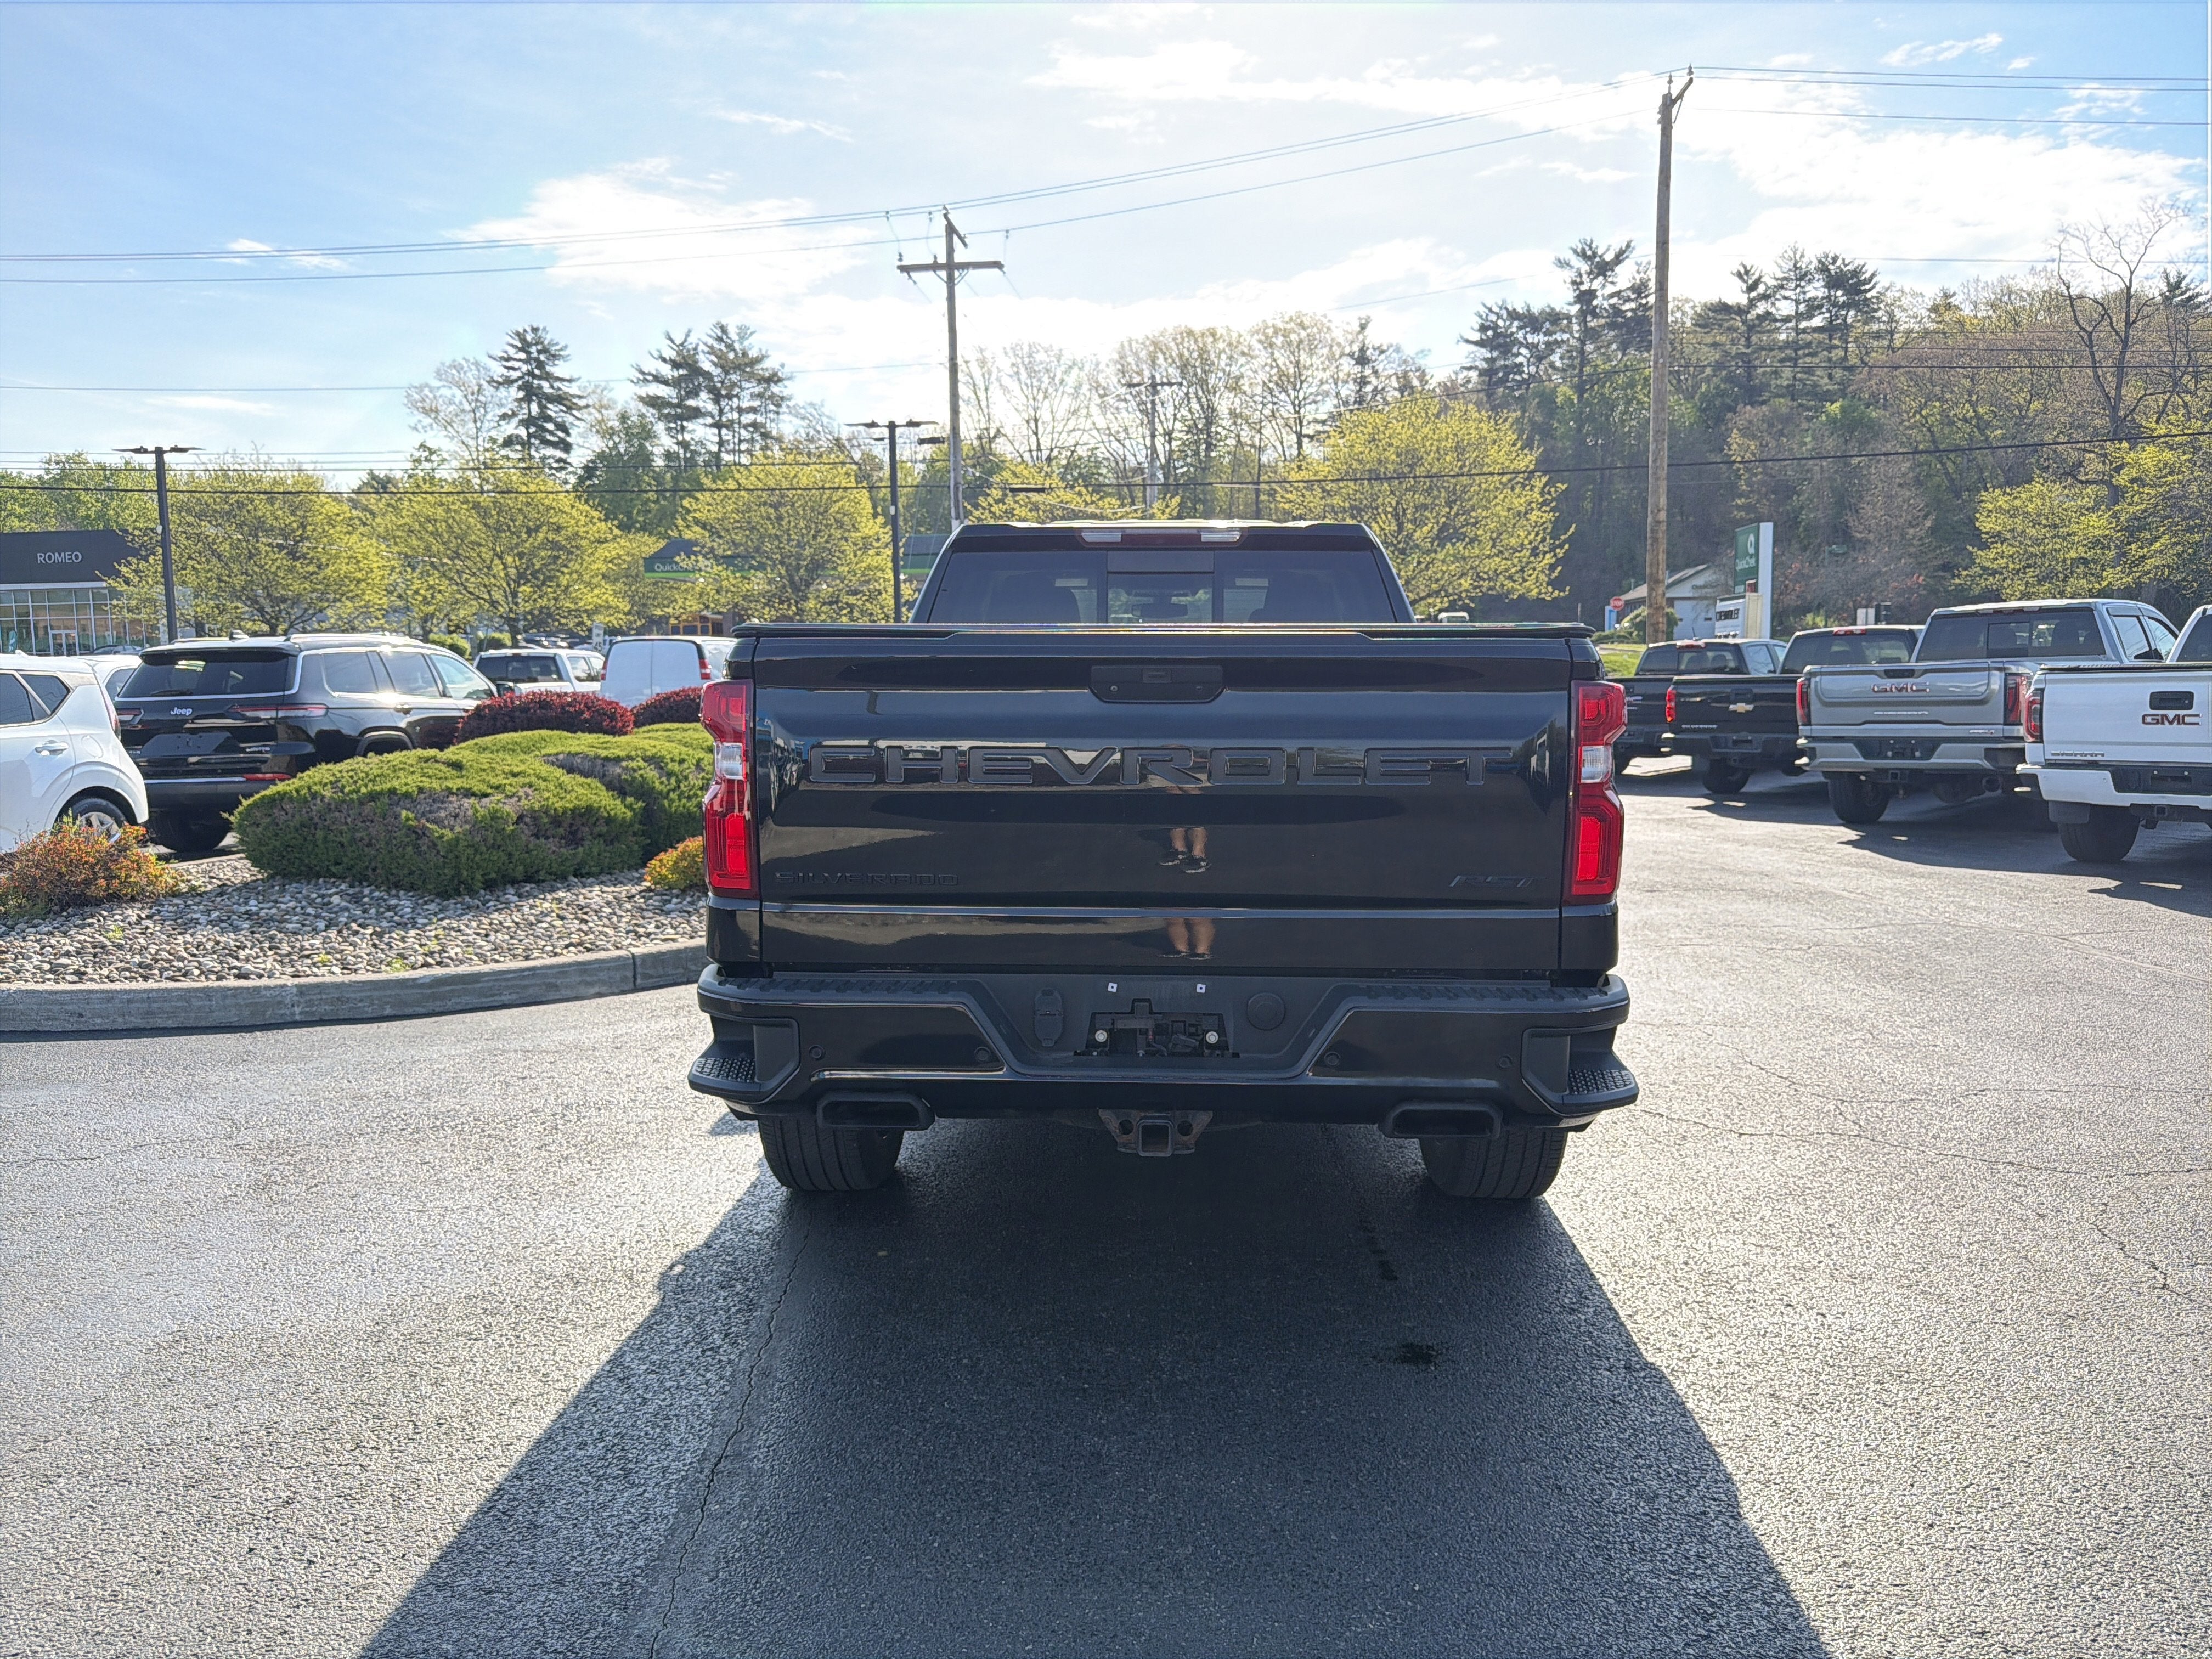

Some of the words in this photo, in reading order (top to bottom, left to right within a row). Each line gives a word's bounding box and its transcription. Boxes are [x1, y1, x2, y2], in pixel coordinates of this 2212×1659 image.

[37, 551, 82, 563] ROMEO
[594, 641, 602, 652] 45
[1871, 681, 1930, 693] GMC
[170, 707, 193, 715] Jeep
[2142, 713, 2202, 726] GMC
[809, 745, 1513, 785] CHEVROLET
[774, 872, 959, 886] SILVERADO
